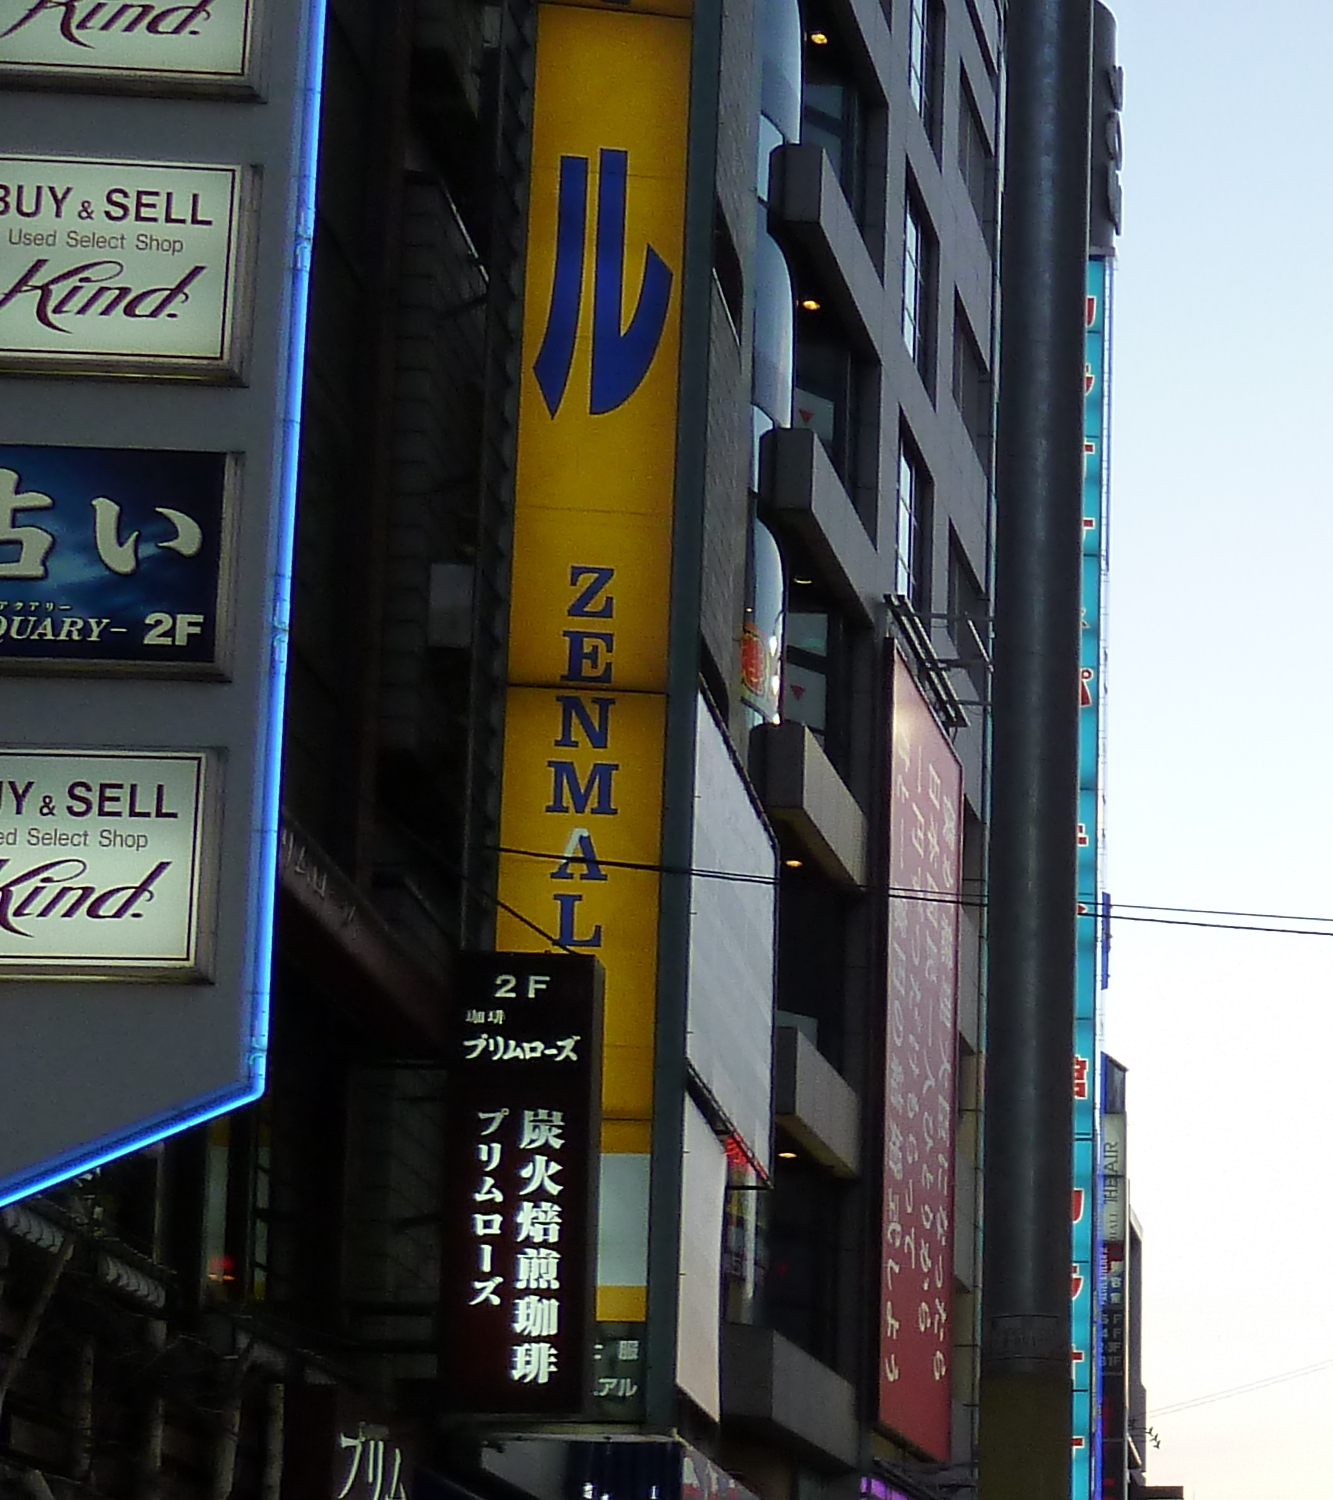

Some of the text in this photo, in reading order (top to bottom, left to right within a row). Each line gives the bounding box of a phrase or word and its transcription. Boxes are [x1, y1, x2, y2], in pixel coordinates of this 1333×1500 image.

[79, 199, 95, 221] &
[103, 189, 214, 226] SELL
[8, 228, 184, 255] Used Select Shop
[2, 258, 207, 333] Kind.
[532, 148, 674, 420] ル
[143, 612, 204, 646] 2F
[0, 780, 178, 819] Y & SELL
[27, 829, 89, 847] Select
[98, 830, 148, 851] Shop
[468, 1107, 510, 1307] プリムローズ
[510, 1107, 567, 1386] 炭火焙煎珈琲
